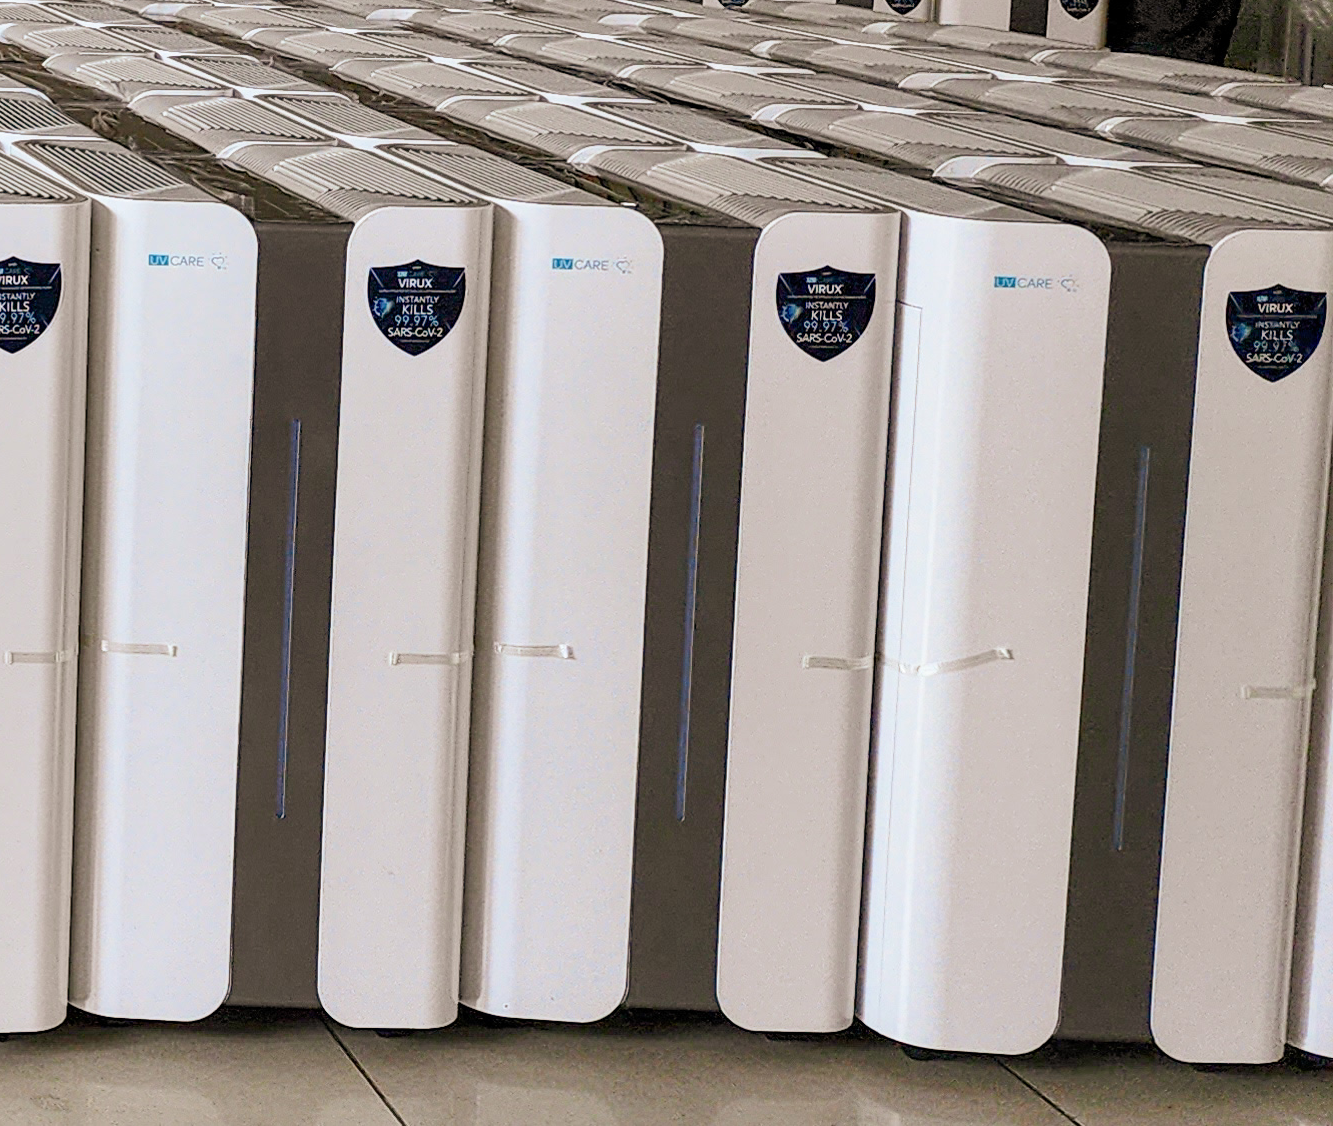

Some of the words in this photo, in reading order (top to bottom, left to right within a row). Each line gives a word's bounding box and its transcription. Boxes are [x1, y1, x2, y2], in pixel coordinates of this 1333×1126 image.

[149, 254, 169, 265] UV
[170, 256, 204, 266] CARE
[553, 258, 573, 269] UV
[574, 259, 609, 270] CARE
[398, 278, 432, 288] VIRUX
[995, 277, 1016, 287] UV
[1018, 277, 1053, 288] CARE
[808, 284, 842, 294] VIRUX
[0, 301, 30, 312] KILLS
[402, 304, 433, 315] KILLS
[1258, 303, 1293, 313] VIRUX
[395, 315, 439, 326] 99.97%
[811, 310, 842, 321] KILLS
[388, 327, 443, 337] SARS-CoV-2
[804, 321, 849, 332] 99.97%
[797, 333, 852, 343] SARS-CoV-2
[1261, 330, 1293, 341] KILLS
